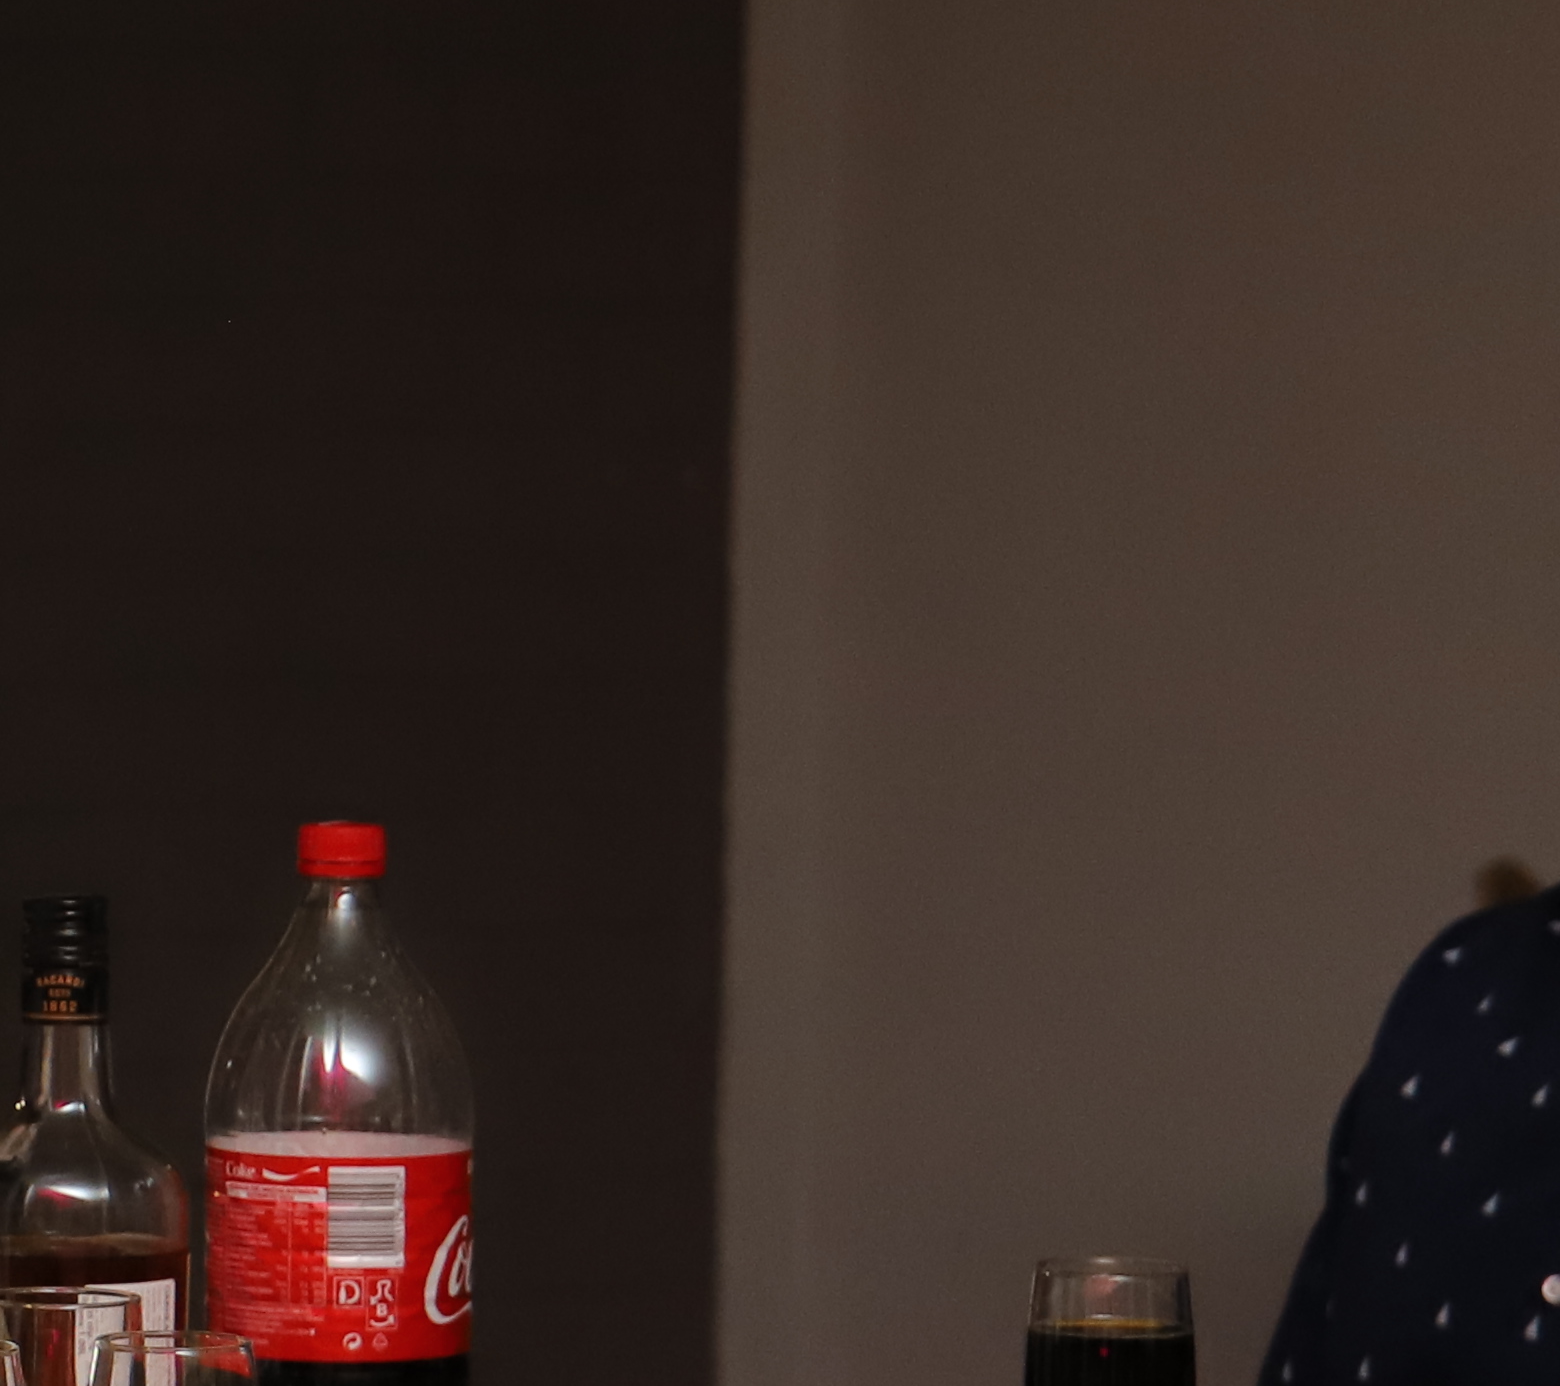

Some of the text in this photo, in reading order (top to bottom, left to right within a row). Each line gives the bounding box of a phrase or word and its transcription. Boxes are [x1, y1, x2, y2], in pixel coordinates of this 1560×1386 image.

[36, 974, 85, 988] BACARDI
[43, 1000, 78, 1012] 1862
[225, 1160, 256, 1179] Coke
